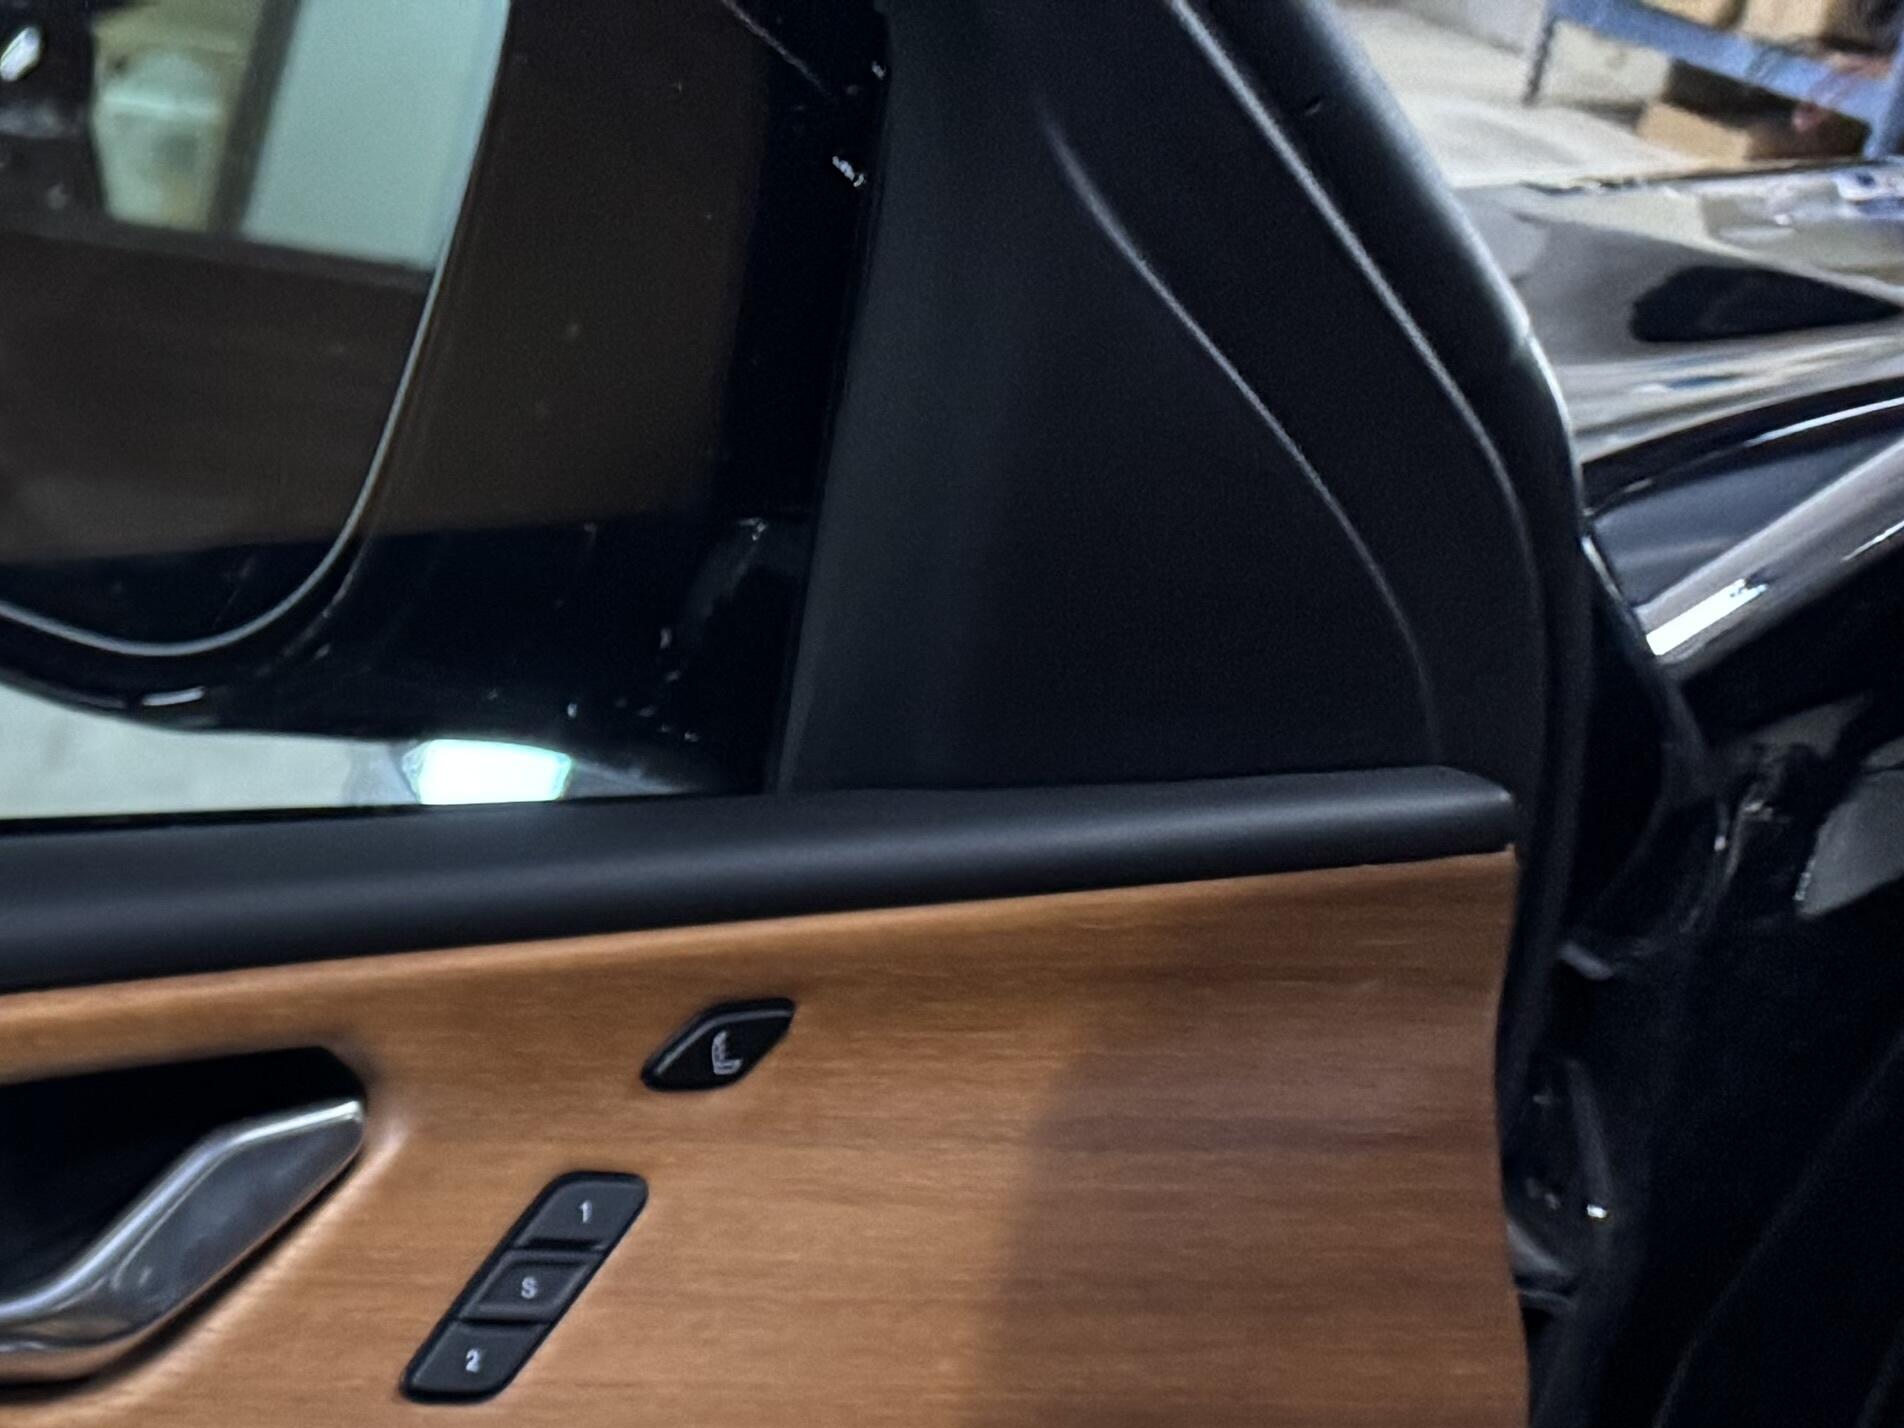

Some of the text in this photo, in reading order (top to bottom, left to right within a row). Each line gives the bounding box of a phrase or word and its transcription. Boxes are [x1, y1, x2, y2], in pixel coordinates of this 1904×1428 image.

[578, 1200, 592, 1223] 1
[520, 1275, 538, 1299] S
[465, 1348, 481, 1373] 2
